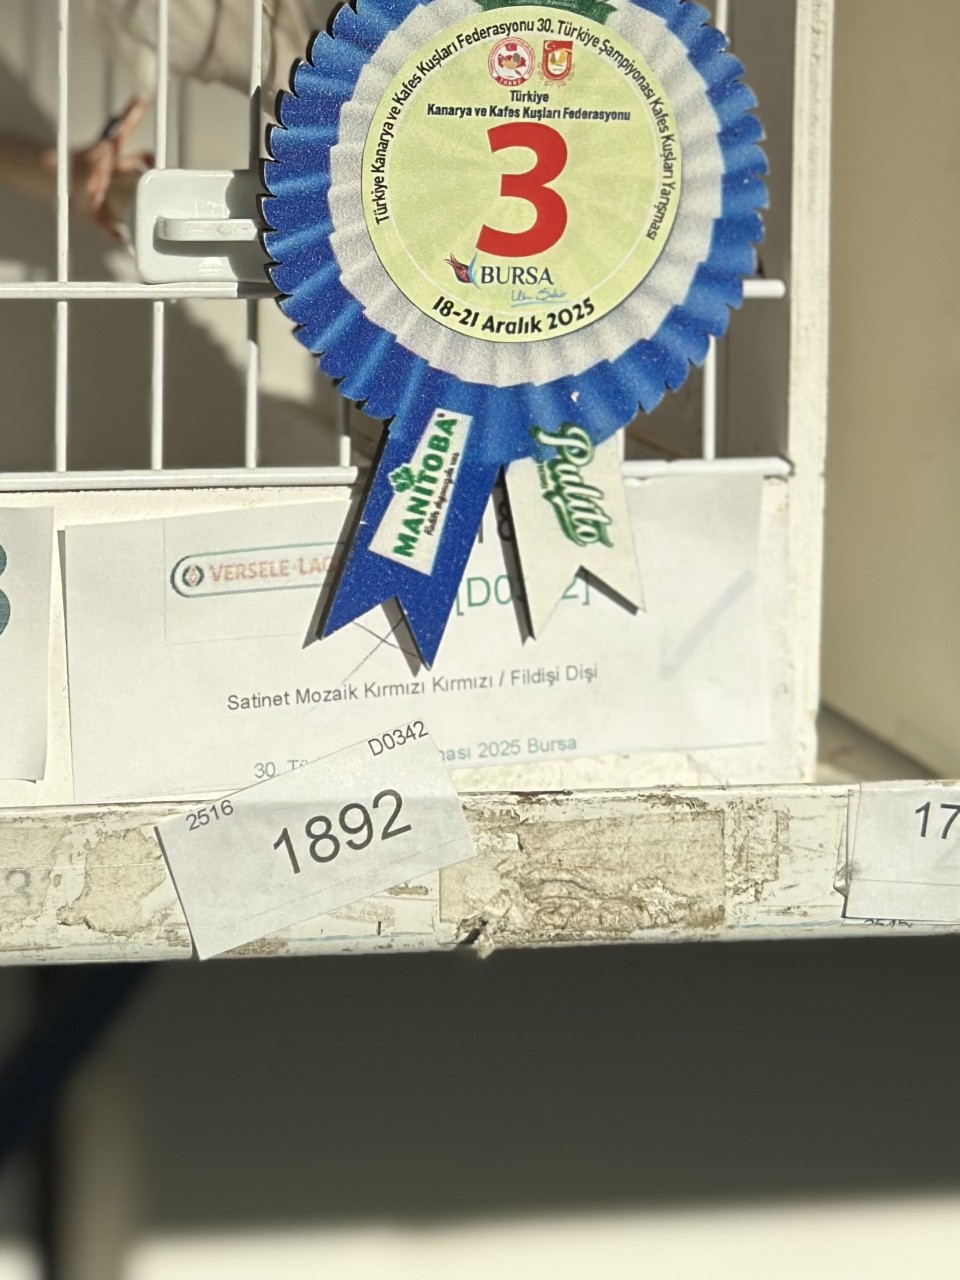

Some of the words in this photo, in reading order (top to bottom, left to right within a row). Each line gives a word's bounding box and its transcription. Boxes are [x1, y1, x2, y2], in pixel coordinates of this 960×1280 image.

[456, 20, 534, 50] Federasyonu
[537, 18, 555, 34] 30.
[558, 20, 600, 48] Türkiye
[416, 41, 459, 76] Kuşları
[597, 39, 656, 101] Şampiyonası
[392, 72, 422, 107] Kafes
[510, 90, 550, 105] Türkiye
[386, 105, 401, 121] ve
[427, 104, 473, 119] Kanarya
[474, 106, 487, 117] ve
[489, 106, 520, 119] Kafes
[523, 107, 561, 121] Kuşları
[563, 107, 631, 121] Federasyonu
[649, 97, 670, 134] Kafes
[371, 121, 395, 174] Kanarya
[659, 133, 677, 180] Kuşları
[371, 176, 390, 225] Türkiye
[476, 122, 569, 258] 3
[645, 181, 676, 241] Yarışması
[480, 266, 554, 286] BURSA
[432, 296, 480, 328] 18-21
[481, 315, 543, 335] Aralık
[546, 297, 595, 331] 2025
[227, 692, 291, 711] Satinet
[295, 683, 359, 705] Mozaik
[364, 679, 426, 699] Kırmızı
[432, 673, 493, 693] Kırmızı
[498, 670, 506, 687] /
[510, 666, 561, 688] Fildişi
[566, 663, 598, 683] Dişi
[368, 720, 428, 757] D0342
[477, 739, 521, 758] 2025
[527, 736, 578, 753] Bursa
[185, 799, 235, 832] 2516
[273, 788, 412, 875] 1892
